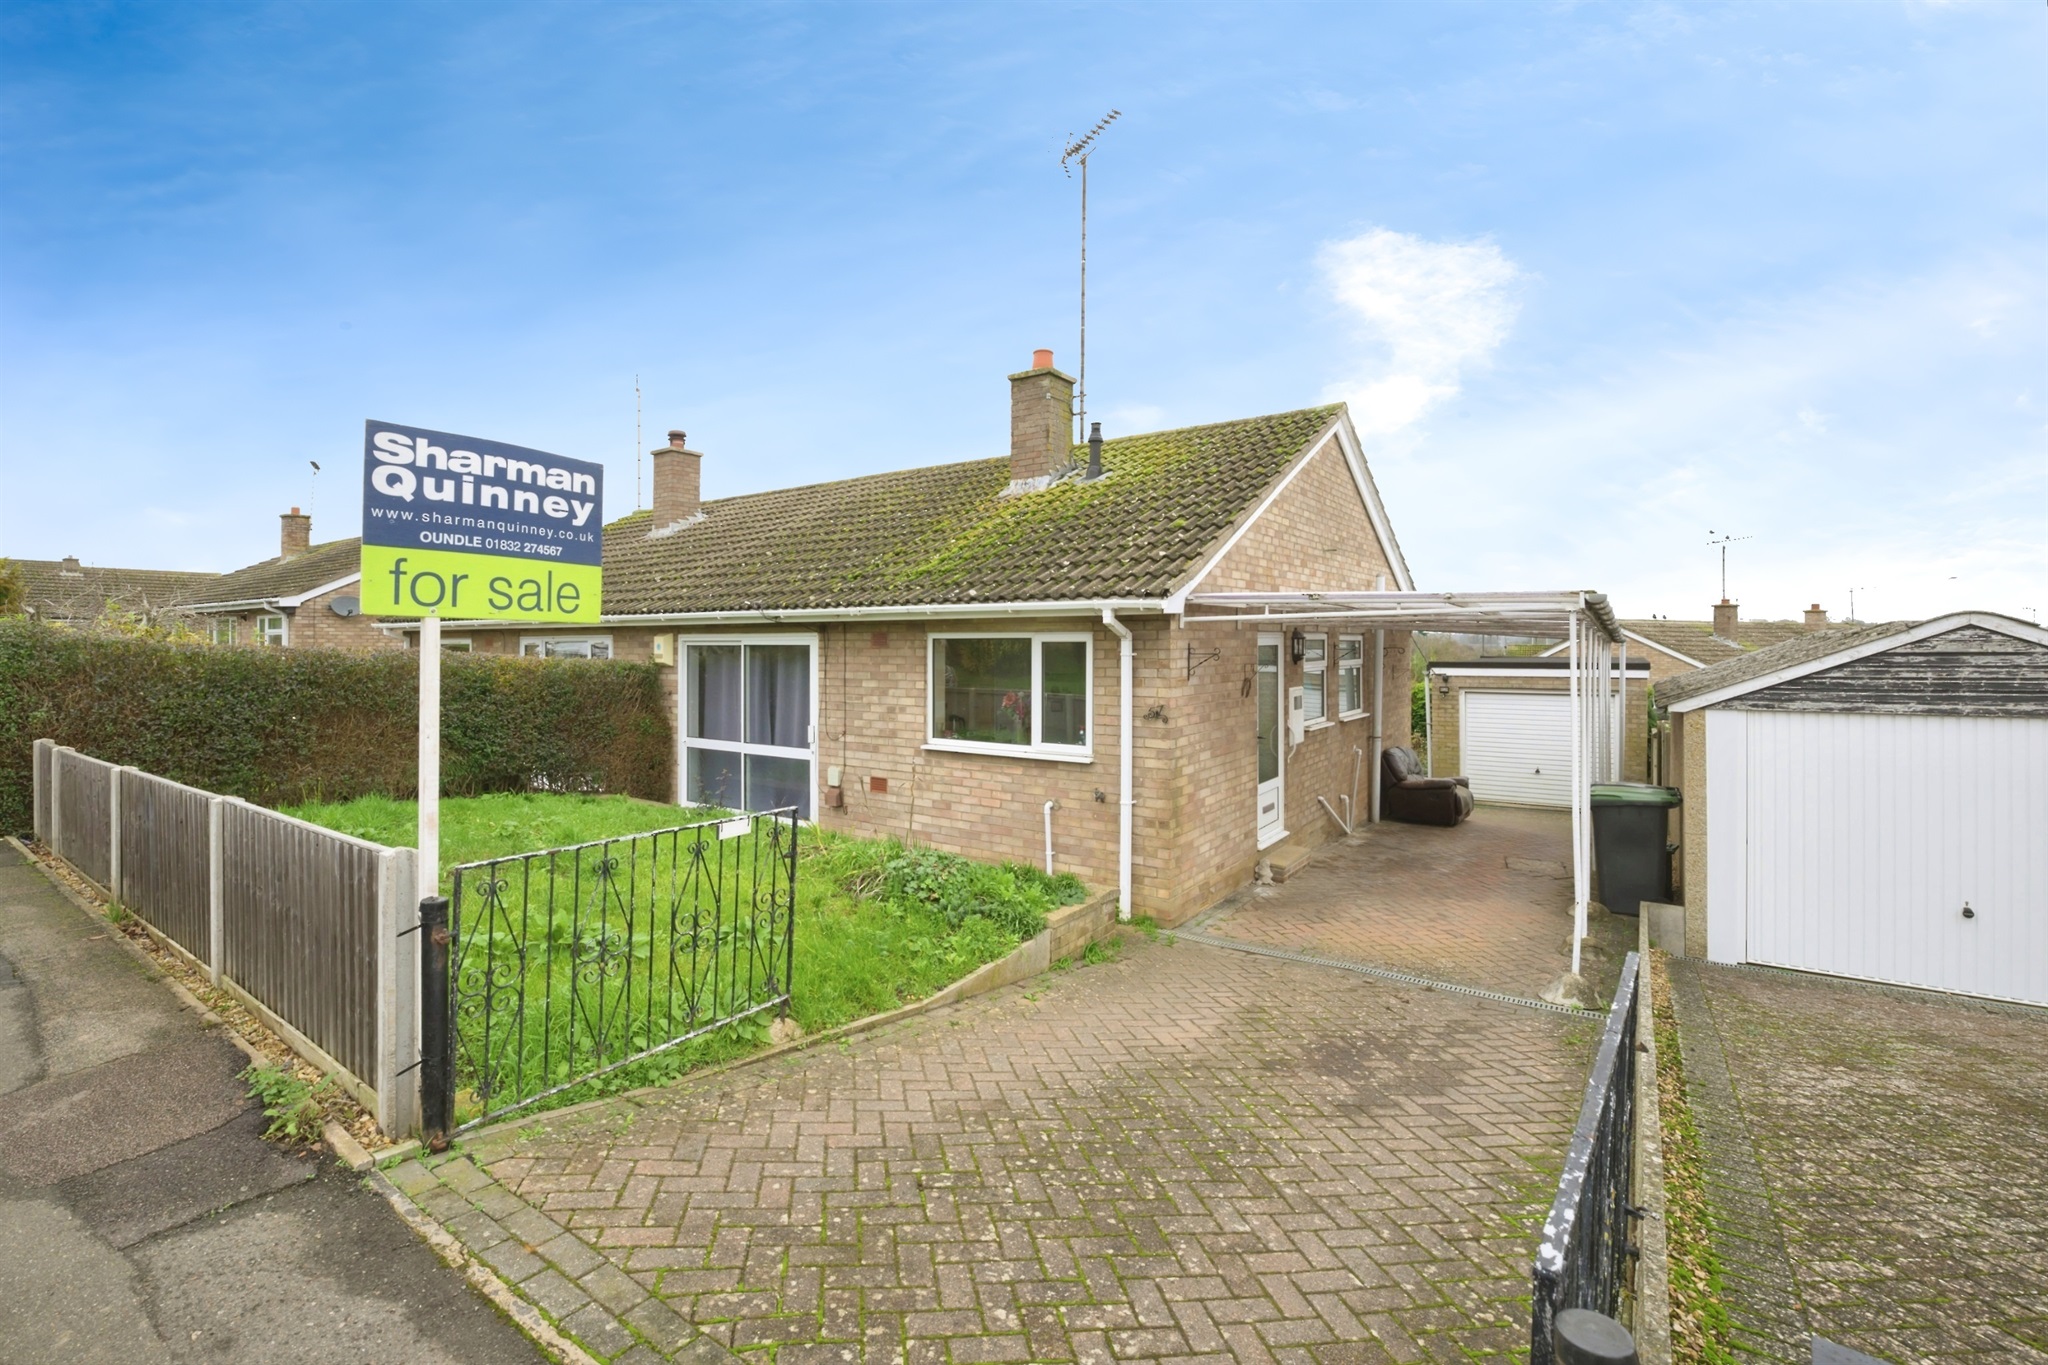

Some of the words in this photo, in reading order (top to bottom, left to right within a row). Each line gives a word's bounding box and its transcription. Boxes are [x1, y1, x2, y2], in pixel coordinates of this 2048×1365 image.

[372, 431, 596, 496] Sharman
[371, 464, 595, 526] Quinney
[371, 507, 595, 543] www.sharmanquinney.co.uk
[419, 531, 482, 548] OUNDLE
[485, 538, 521, 552] 01832
[523, 542, 563, 557] 274567
[389, 557, 469, 608] for
[488, 570, 580, 614] sale
